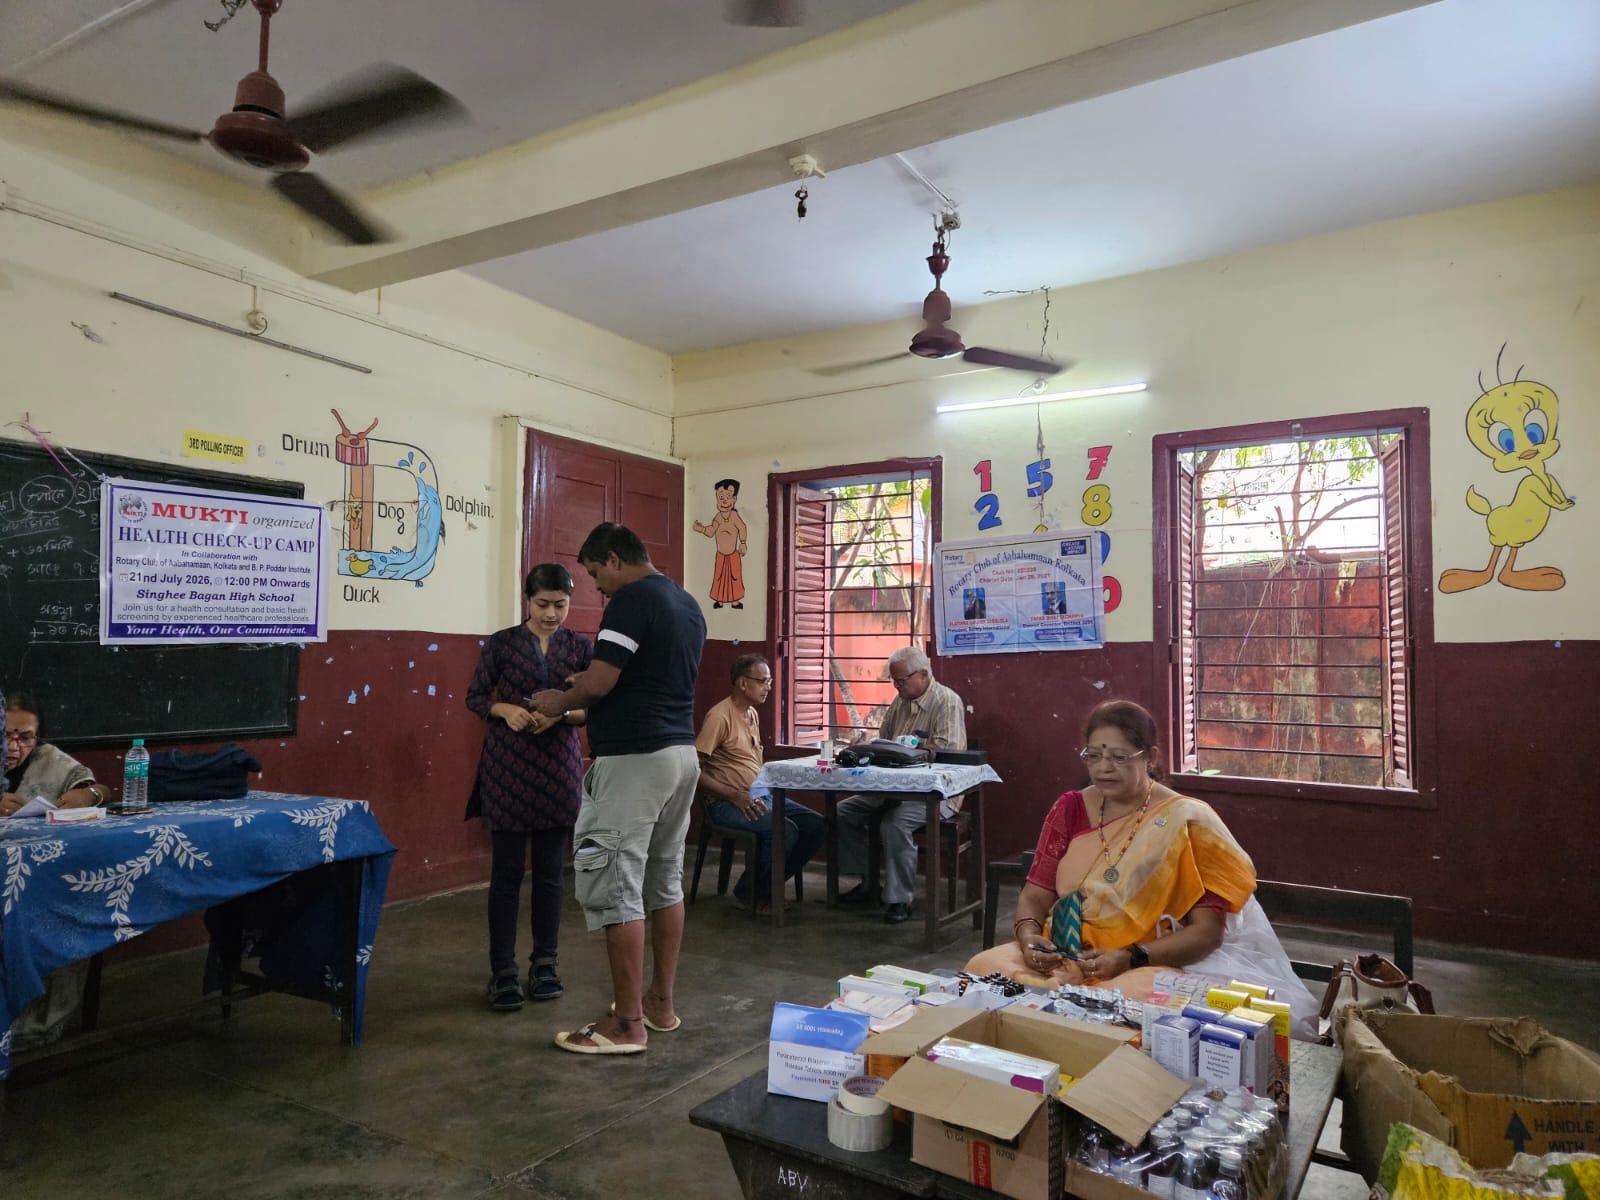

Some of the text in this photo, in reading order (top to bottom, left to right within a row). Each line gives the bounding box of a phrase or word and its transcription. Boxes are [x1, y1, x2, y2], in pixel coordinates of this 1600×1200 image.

[189, 437, 244, 457] 3RD POLLING OFFICER
[282, 434, 330, 458] Drum
[1085, 445, 1113, 481] 7
[973, 459, 992, 493] 1
[1025, 458, 1054, 498] 5
[974, 493, 1003, 531] 2
[1080, 483, 1113, 527] 8
[152, 502, 248, 525] MUKTI
[252, 516, 315, 530] organized
[377, 501, 405, 535] Dog
[119, 526, 315, 553] HEALTH CHECK-UP CAMP
[115, 557, 140, 567] Rotary
[160, 559, 167, 567] of
[213, 562, 237, 570] Kolkata
[238, 563, 250, 571] and
[259, 564, 265, 572] P.
[266, 564, 286, 573] Poddar
[181, 550, 189, 558] In
[191, 551, 241, 561] Collaboration
[973, 557, 992, 574] Club
[992, 552, 1001, 565] of
[1055, 557, 1087, 587] Kolkata
[129, 572, 158, 583] 21nd
[160, 573, 182, 586] July
[224, 576, 250, 587] 12:00
[252, 577, 267, 587] PM
[269, 578, 311, 589] Onwards
[136, 589, 295, 603] Singhee Bagan High School
[343, 584, 380, 604] Duck
[117, 613, 160, 623] screening
[161, 613, 172, 623] by
[173, 614, 222, 623] experienced
[224, 614, 263, 622] healthcare
[123, 603, 141, 612] Join
[156, 603, 168, 612] for
[177, 604, 202, 613] health
[203, 605, 249, 613] consultation
[266, 606, 286, 614] basic
[126, 625, 157, 635] Your
[209, 625, 234, 635] Our
[236, 625, 306, 635] Commitment.
[1533, 1119, 1595, 1134] HANDLE
[1548, 1141, 1585, 1152] WITH
